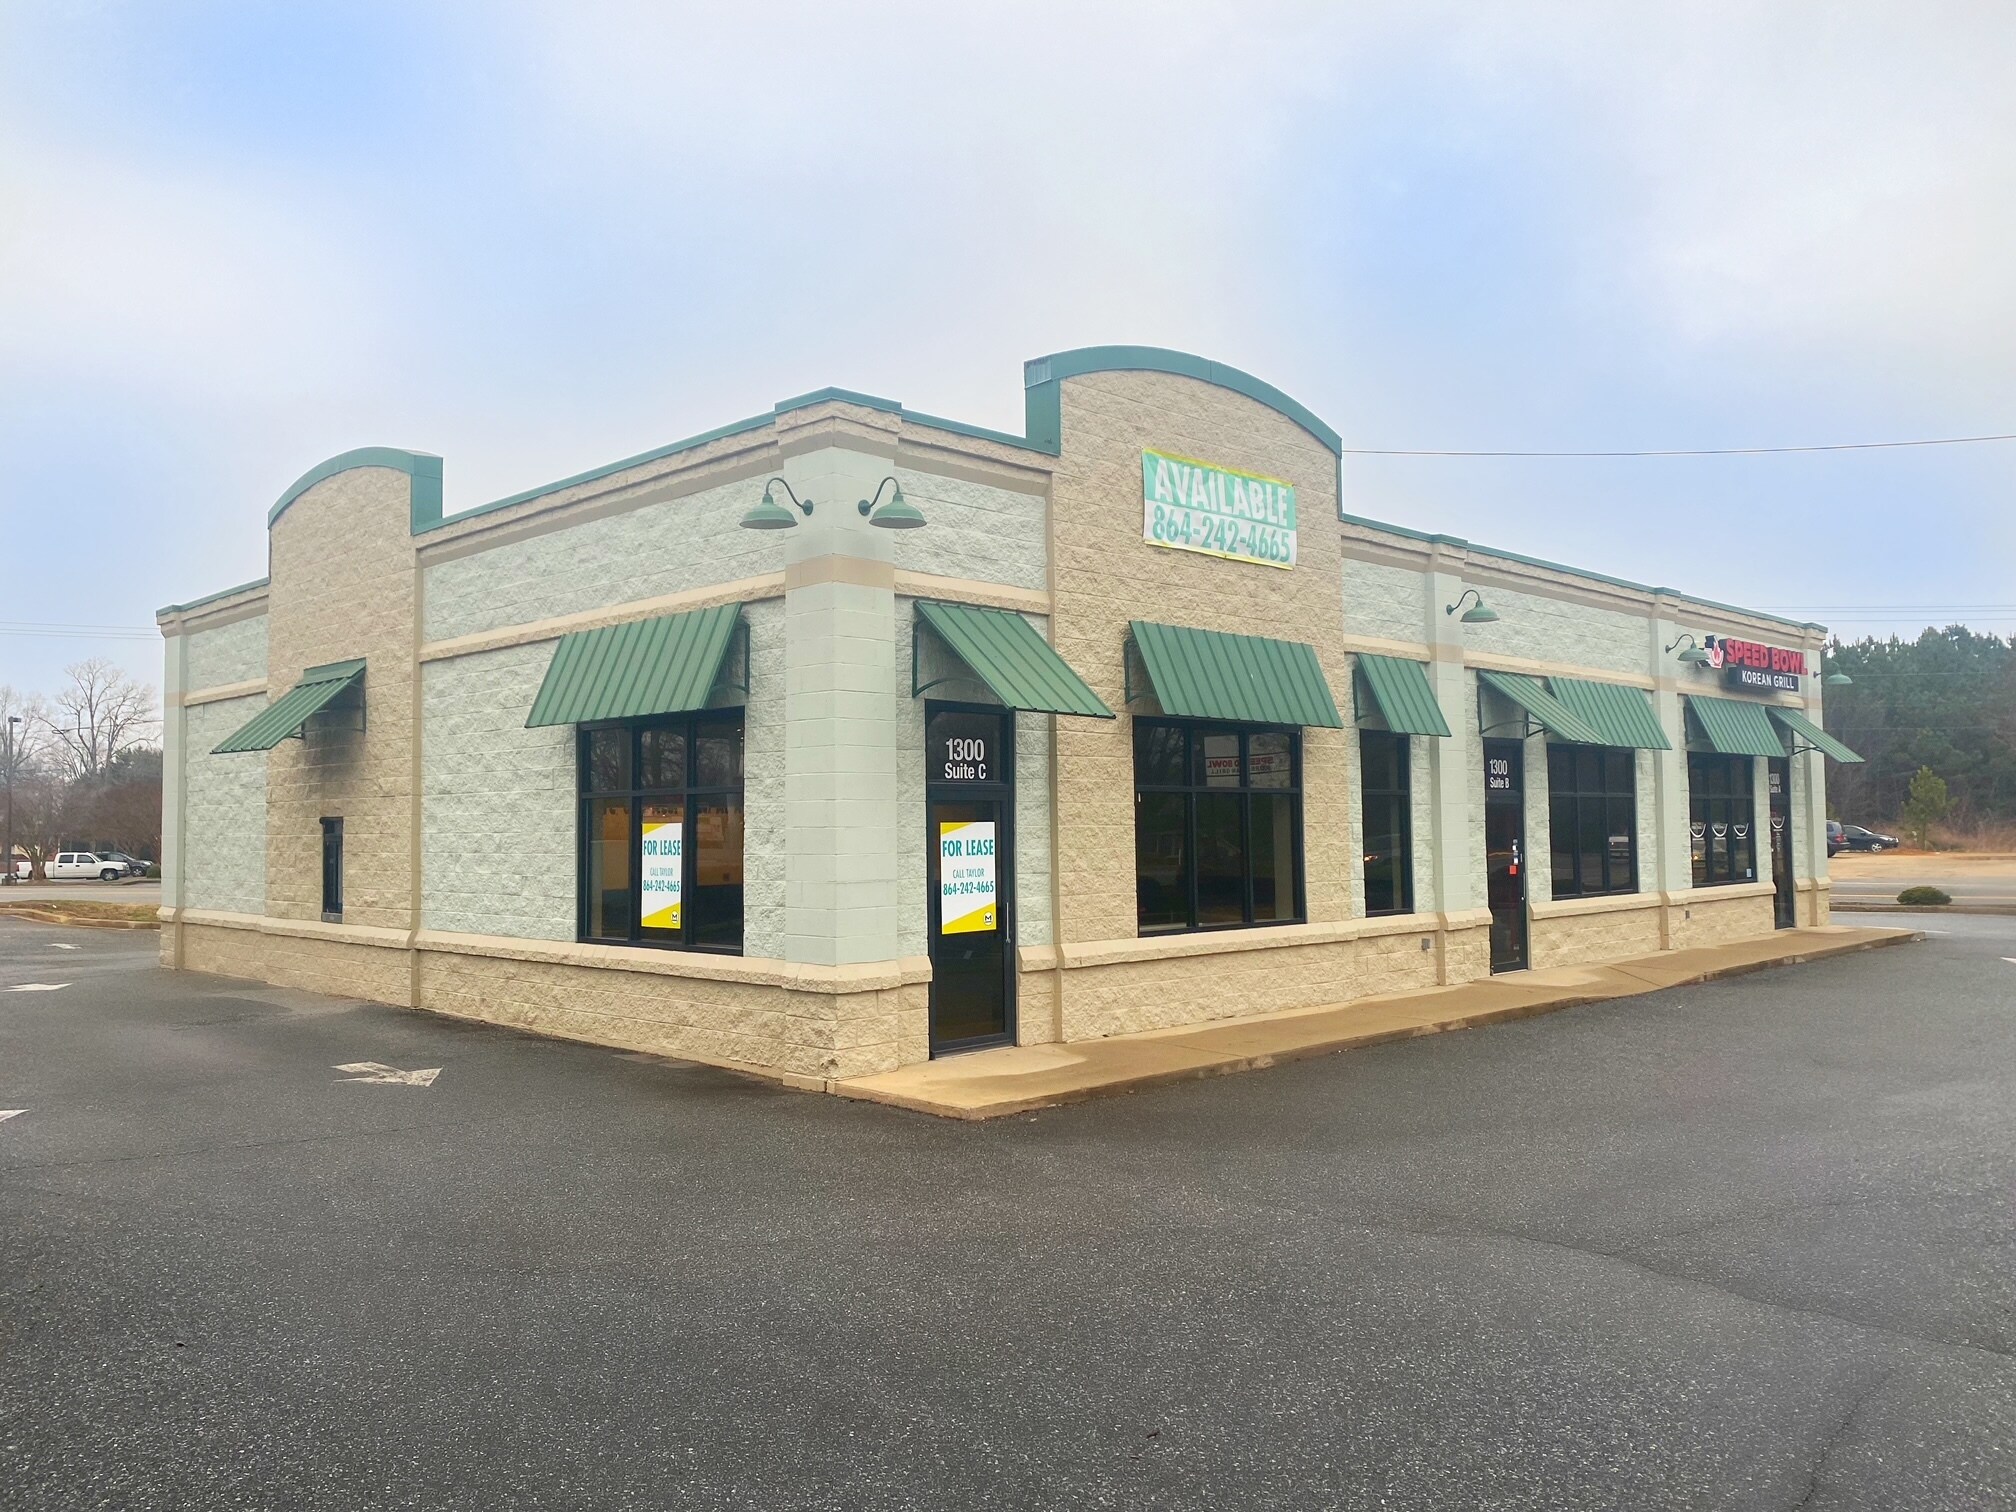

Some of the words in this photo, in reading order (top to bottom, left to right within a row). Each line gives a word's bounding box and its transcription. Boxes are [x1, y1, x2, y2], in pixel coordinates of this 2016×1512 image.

[1154, 458, 1288, 526] AVAILABLE
[1152, 504, 1291, 562] 864-242-4665
[1725, 638, 1769, 668] SPEED
[1771, 647, 1808, 675] BOWL
[1742, 670, 1772, 686] KOREAN
[1773, 675, 1795, 689] GRILL
[945, 738, 985, 761] 1300
[944, 762, 975, 779] Suite
[978, 763, 987, 779] C
[1489, 759, 1508, 775] 1300
[1489, 776, 1504, 788] Suite
[1505, 777, 1509, 788] B
[643, 840, 658, 856] FOR
[660, 840, 681, 856] LEASE
[942, 840, 962, 857] FOR
[966, 839, 994, 856] LEASE
[650, 867, 659, 877] CALL
[952, 868, 965, 879] CALL
[966, 868, 985, 878] TAYLOR
[643, 879, 681, 892] 864-242-4665
[943, 880, 995, 896] 864-242-4665
